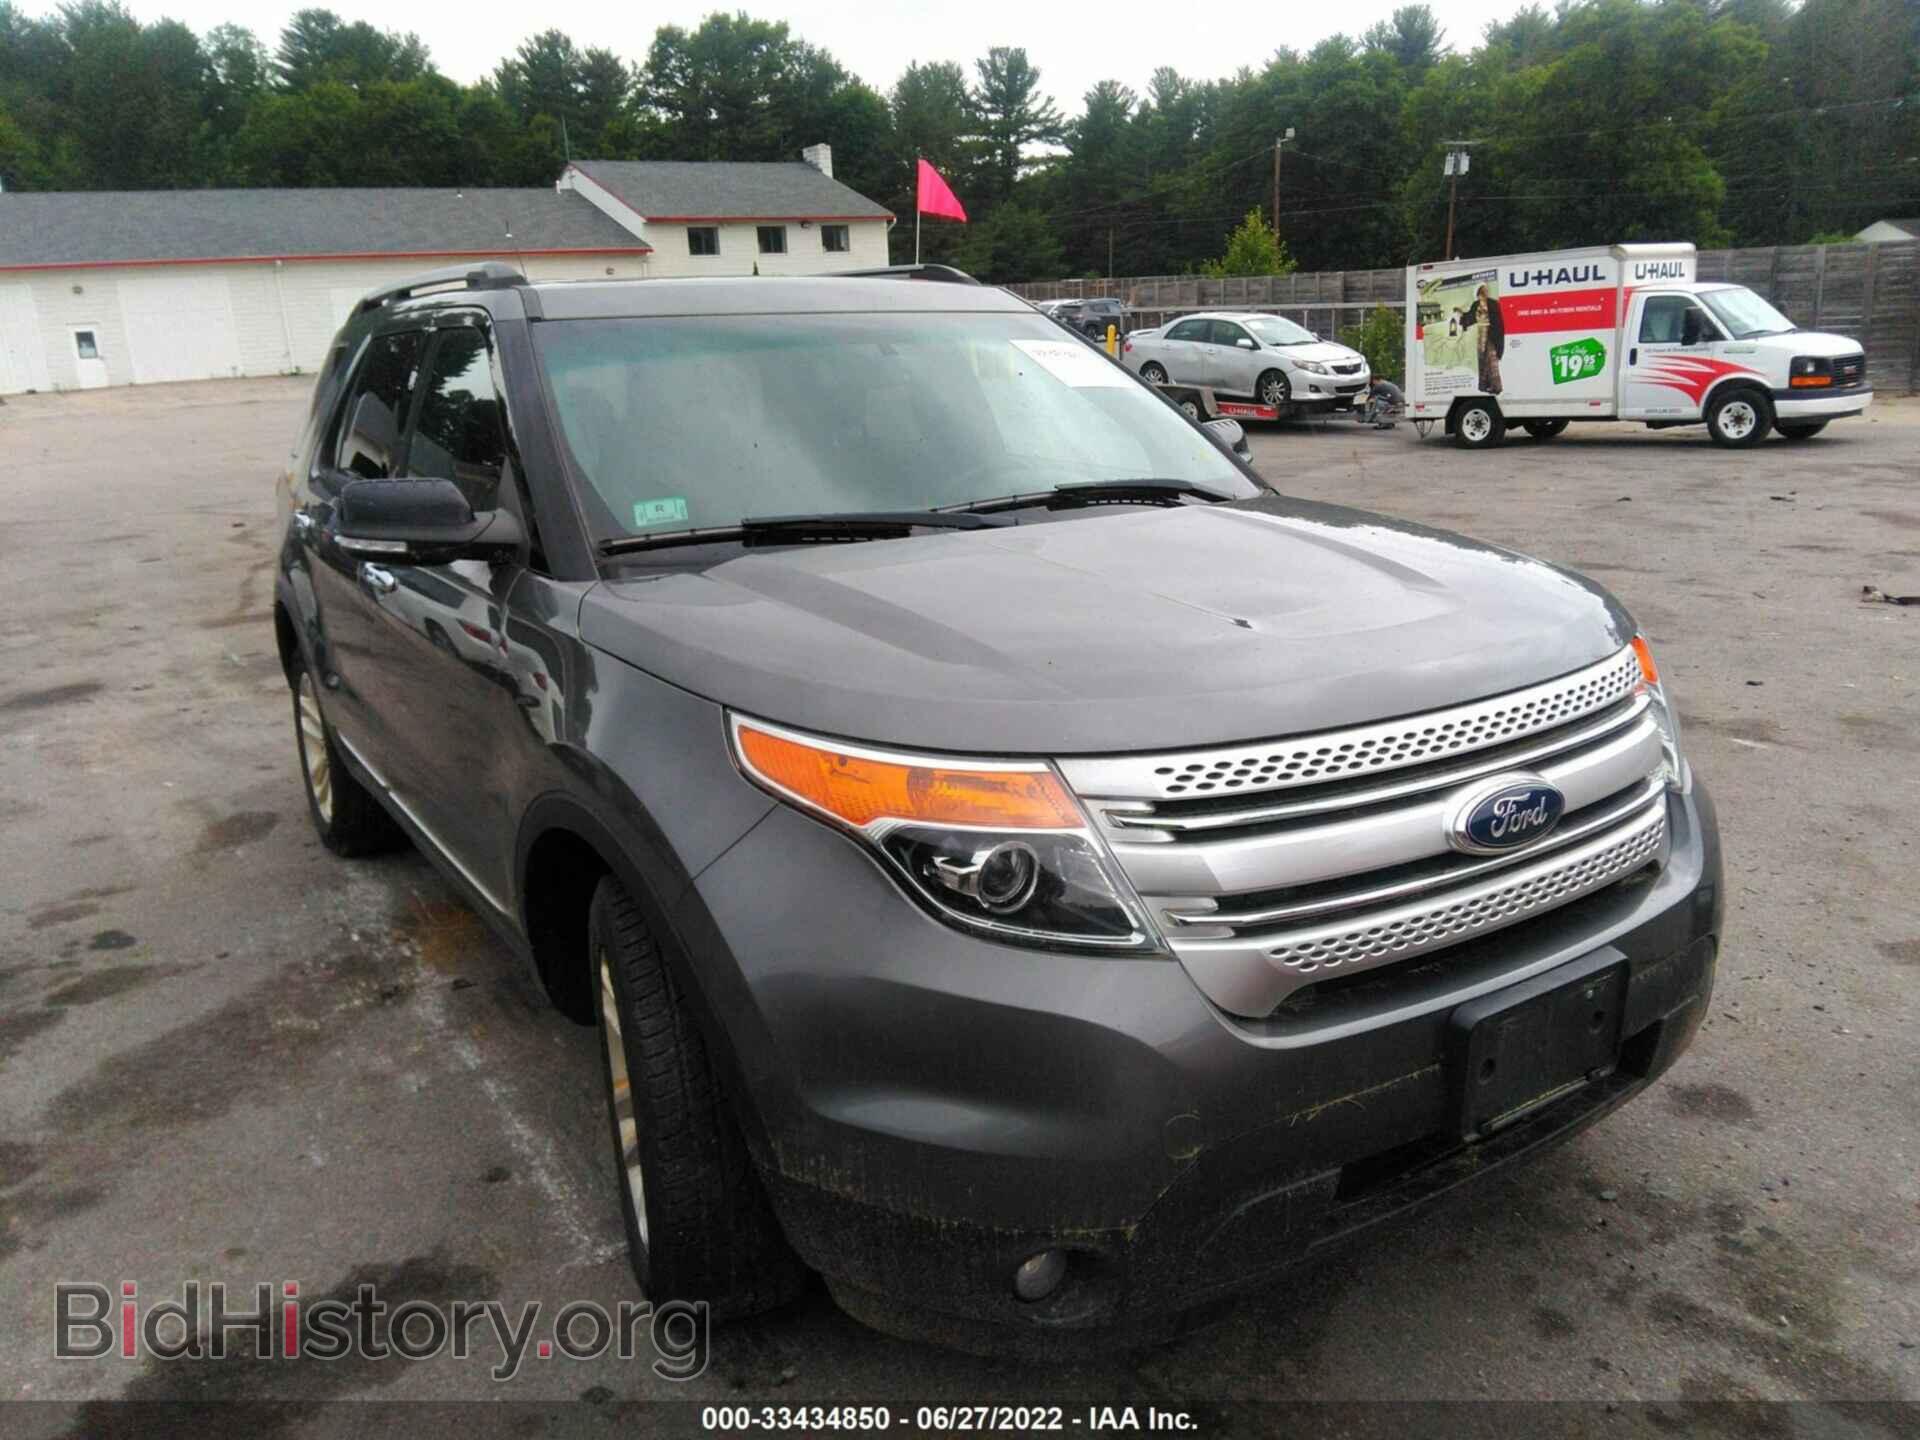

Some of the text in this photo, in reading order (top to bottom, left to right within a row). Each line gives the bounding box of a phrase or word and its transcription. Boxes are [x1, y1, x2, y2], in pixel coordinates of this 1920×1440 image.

[1510, 265, 1606, 287] U-HAUL
[1635, 262, 1685, 280] U-HAUL
[1490, 792, 1549, 838] Ford
